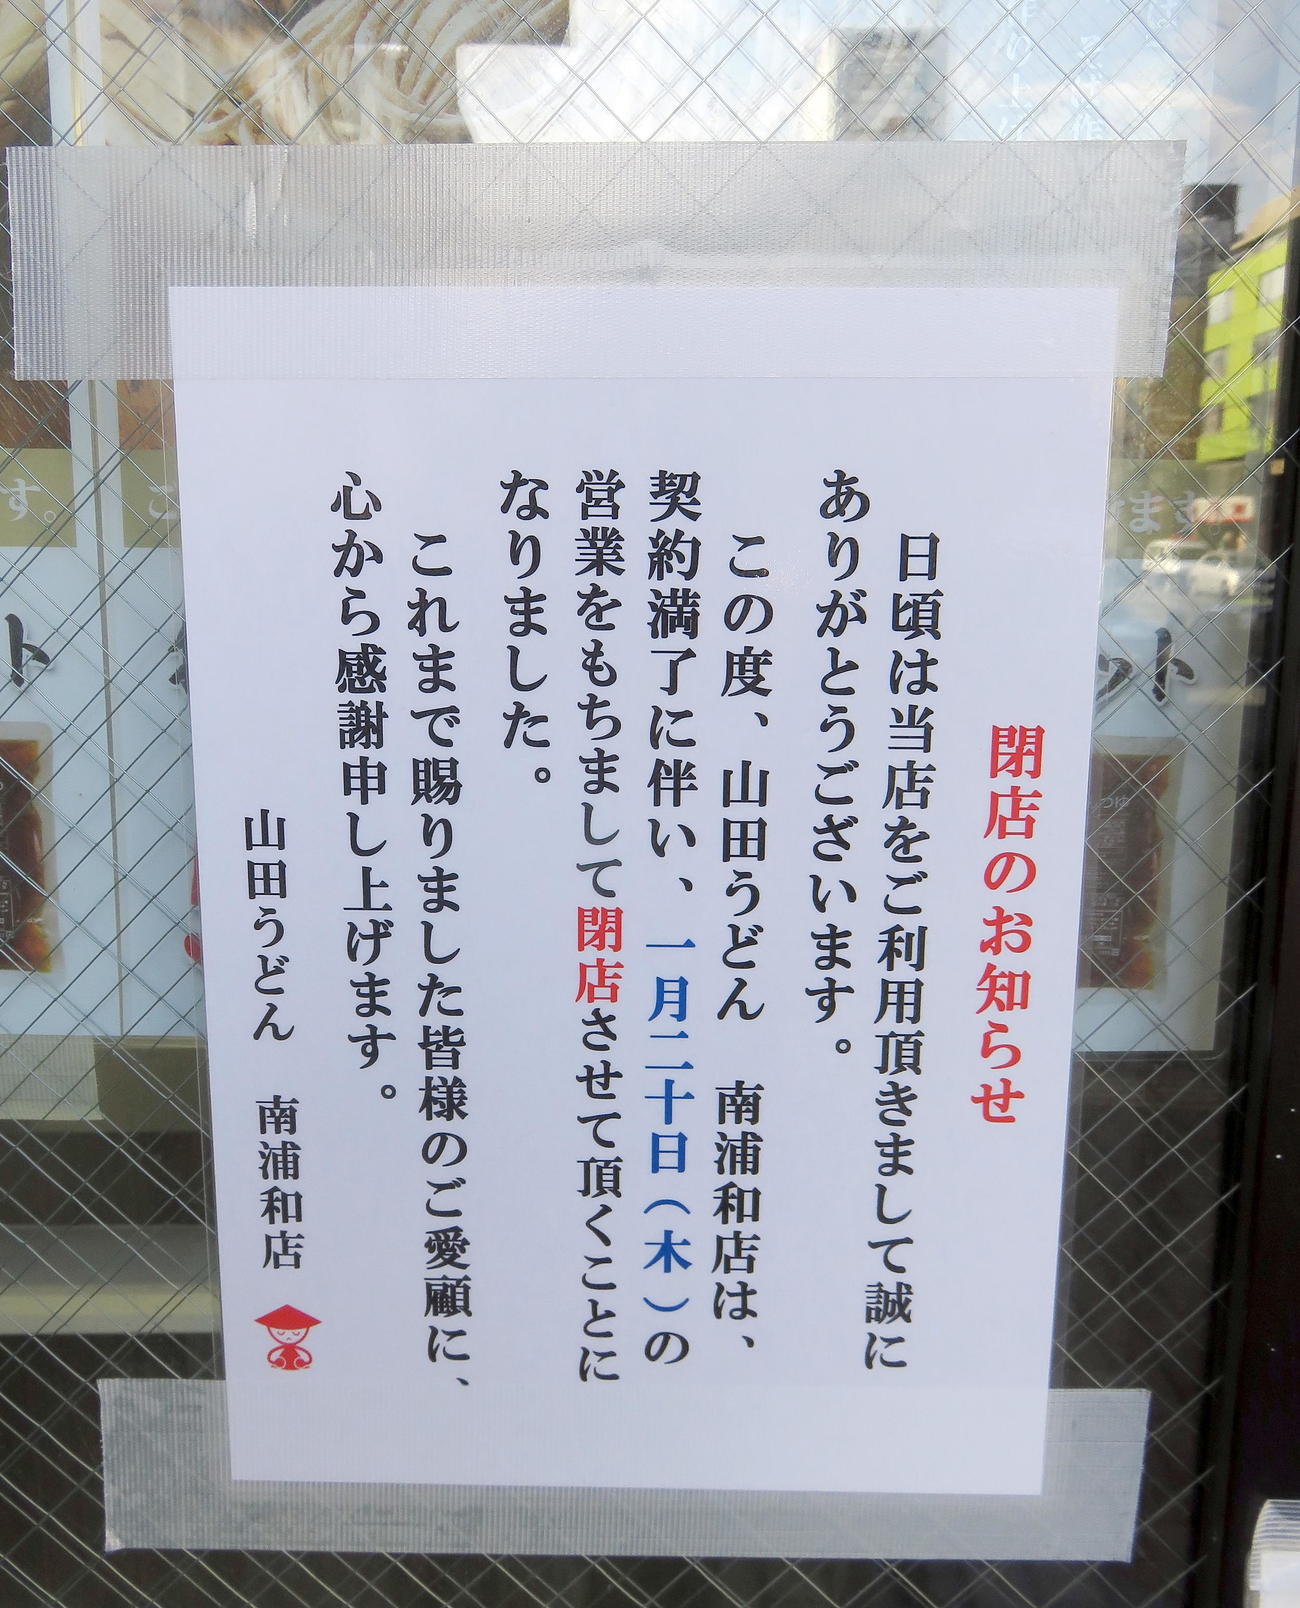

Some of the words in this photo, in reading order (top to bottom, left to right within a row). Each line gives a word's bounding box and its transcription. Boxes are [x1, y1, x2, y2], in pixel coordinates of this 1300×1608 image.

[330, 471, 396, 1100] 心から感謝申し上げます。
[500, 470, 551, 784] なりました。
[805, 469, 870, 1055] ありがとうございます。
[245, 809, 295, 1042] 山田うどん
[407, 533, 472, 1387] これまで賜りました皆様のご愛顧に、
[575, 469, 626, 1382] 営業をもちまして閉店させて頂くことに
[864, 532, 944, 1369] 日頃は当店をご利用頂きまして誠に
[971, 725, 1045, 1123] 閉店のお知らせ
[256, 1095, 305, 1270] 南浦和店
[712, 1080, 765, 1348] 南浦和店は、
